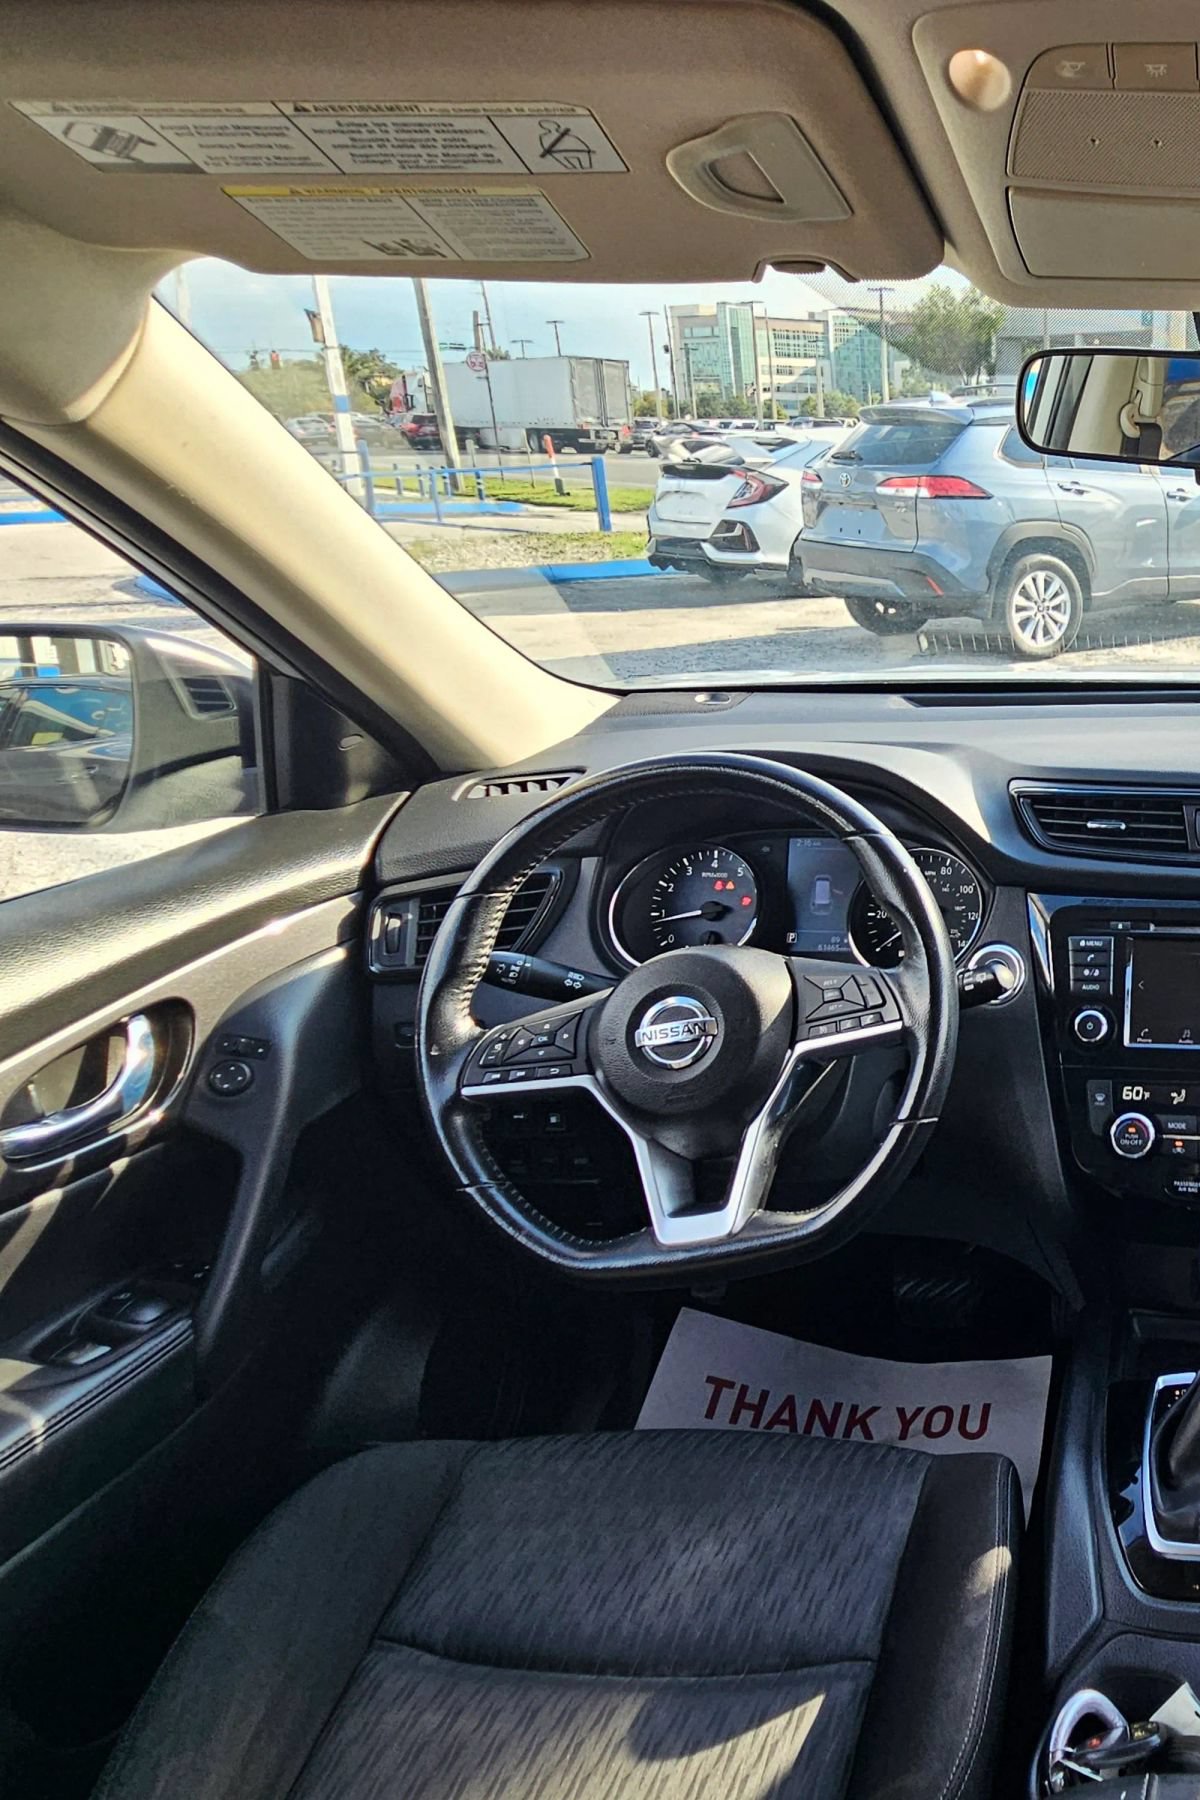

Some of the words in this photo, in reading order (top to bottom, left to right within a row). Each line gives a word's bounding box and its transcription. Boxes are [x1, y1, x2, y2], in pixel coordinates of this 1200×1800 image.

[711, 859, 718, 868] 4
[686, 867, 692, 875] 3
[737, 868, 743, 876] 5
[941, 867, 952, 875] 80
[668, 883, 674, 892] 2
[960, 885, 974, 893] 100
[876, 910, 887, 919] 20
[668, 934, 674, 943] 0
[641, 1022, 707, 1041] NISSAN
[1168, 1122, 1187, 1130] MODE
[704, 1375, 881, 1441] THANK
[895, 1402, 992, 1441] YOU
